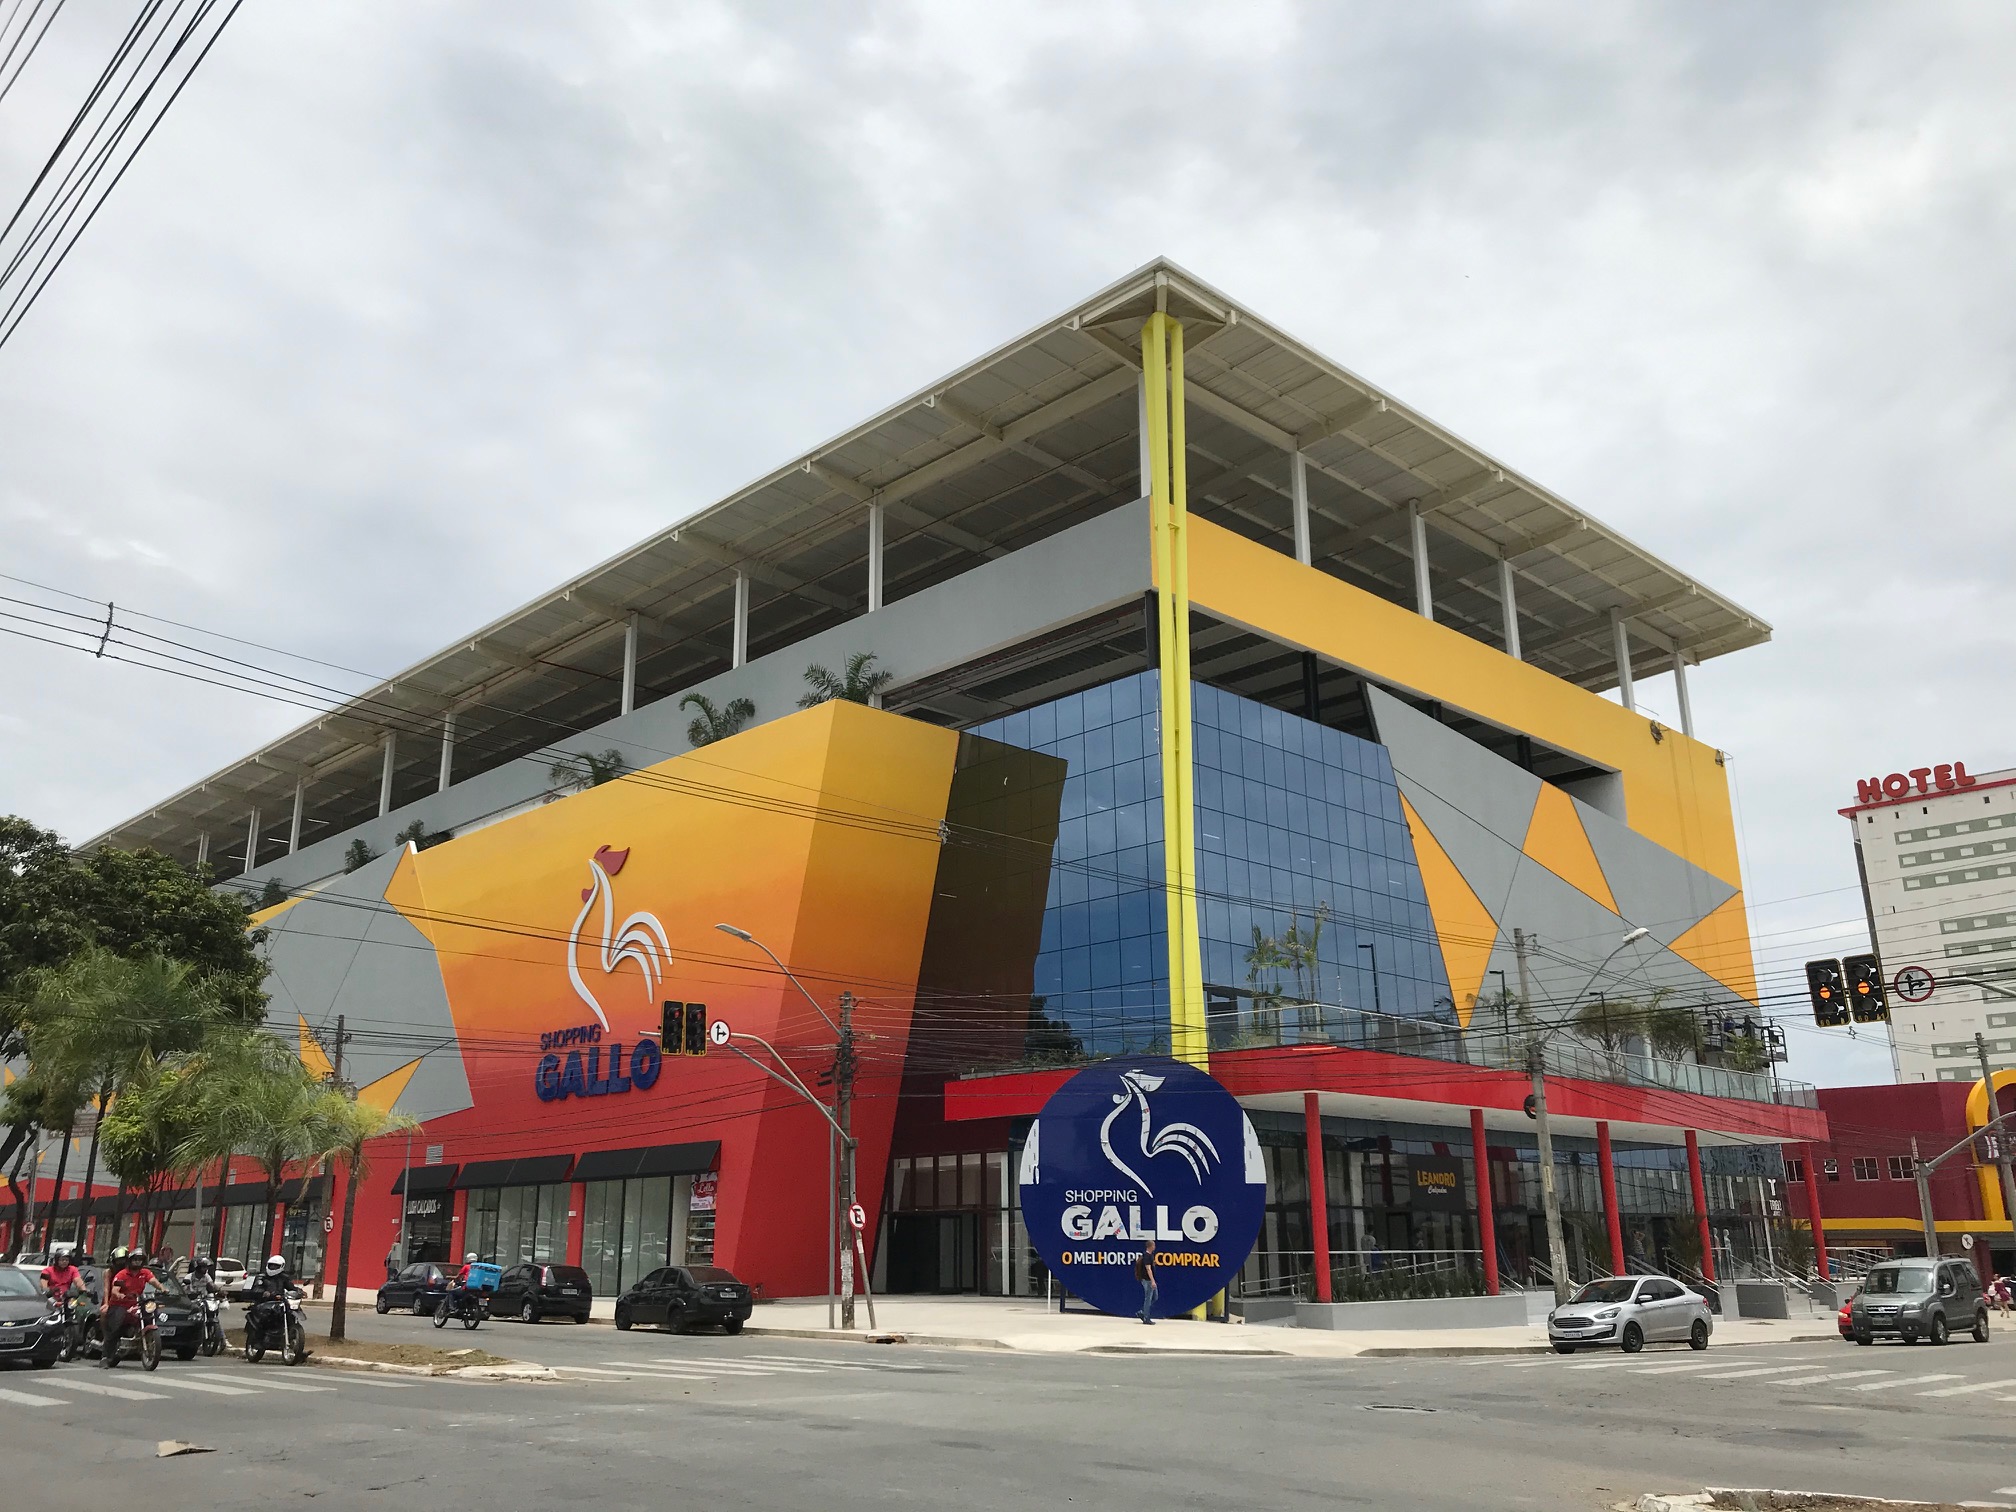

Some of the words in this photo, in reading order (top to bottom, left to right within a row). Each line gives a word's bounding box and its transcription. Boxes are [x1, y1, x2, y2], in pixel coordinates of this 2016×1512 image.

[1857, 761, 1976, 804] HOTEL
[540, 1023, 601, 1050] SHOPPING
[535, 1038, 662, 1102] GALLO
[1416, 1169, 1456, 1188] LEANDRO
[1061, 1204, 1219, 1243] GALLO
[1061, 1251, 1073, 1265] O
[1073, 1251, 1126, 1266] MELHOR
[1154, 1252, 1220, 1268] COMPRAR
